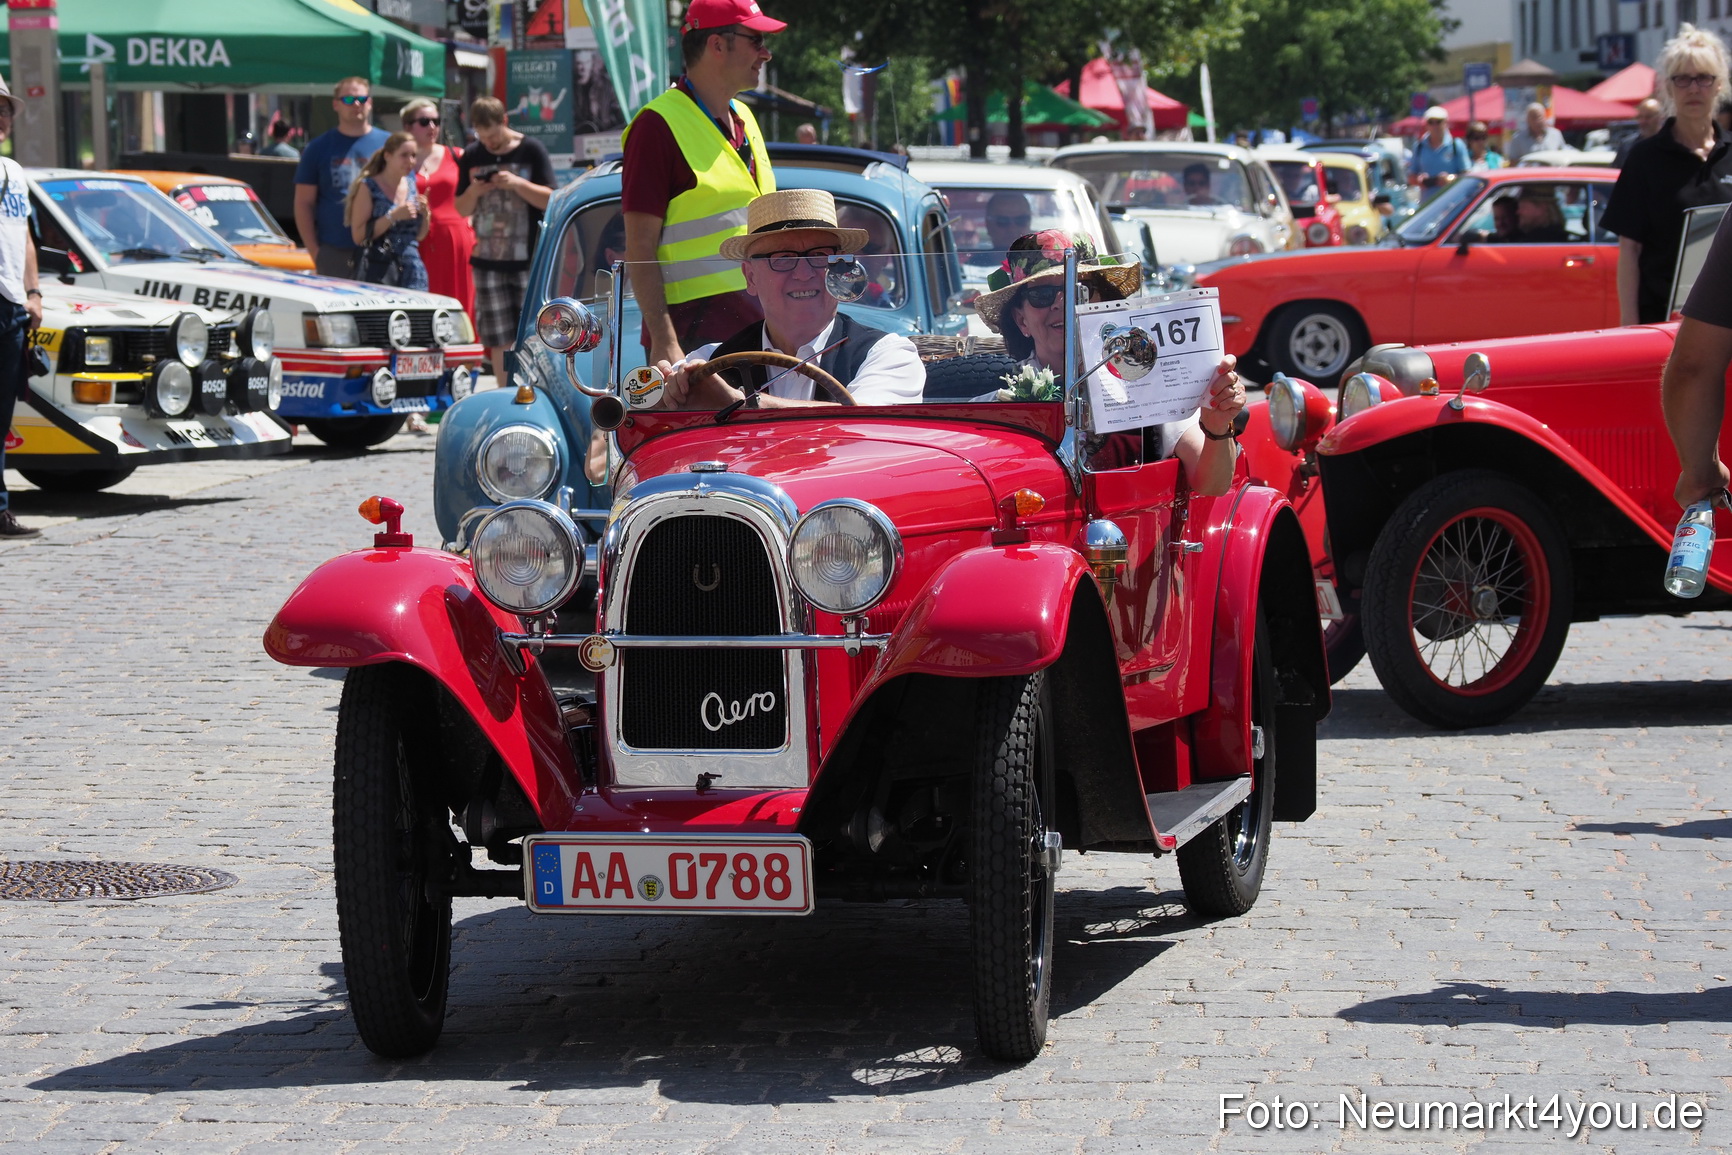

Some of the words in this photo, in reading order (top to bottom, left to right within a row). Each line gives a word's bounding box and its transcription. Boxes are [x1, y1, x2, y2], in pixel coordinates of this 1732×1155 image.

[127, 37, 231, 67] DEKRA
[134, 280, 182, 301] JIM
[192, 288, 271, 312] BEAM
[1151, 317, 1201, 347] 167
[202, 379, 227, 393] BOSCH
[248, 376, 268, 390] BOSCH
[281, 381, 325, 399] astrol
[700, 691, 776, 732] Aero
[543, 881, 554, 895] D
[571, 852, 634, 899] AA
[668, 852, 792, 901] 0788
